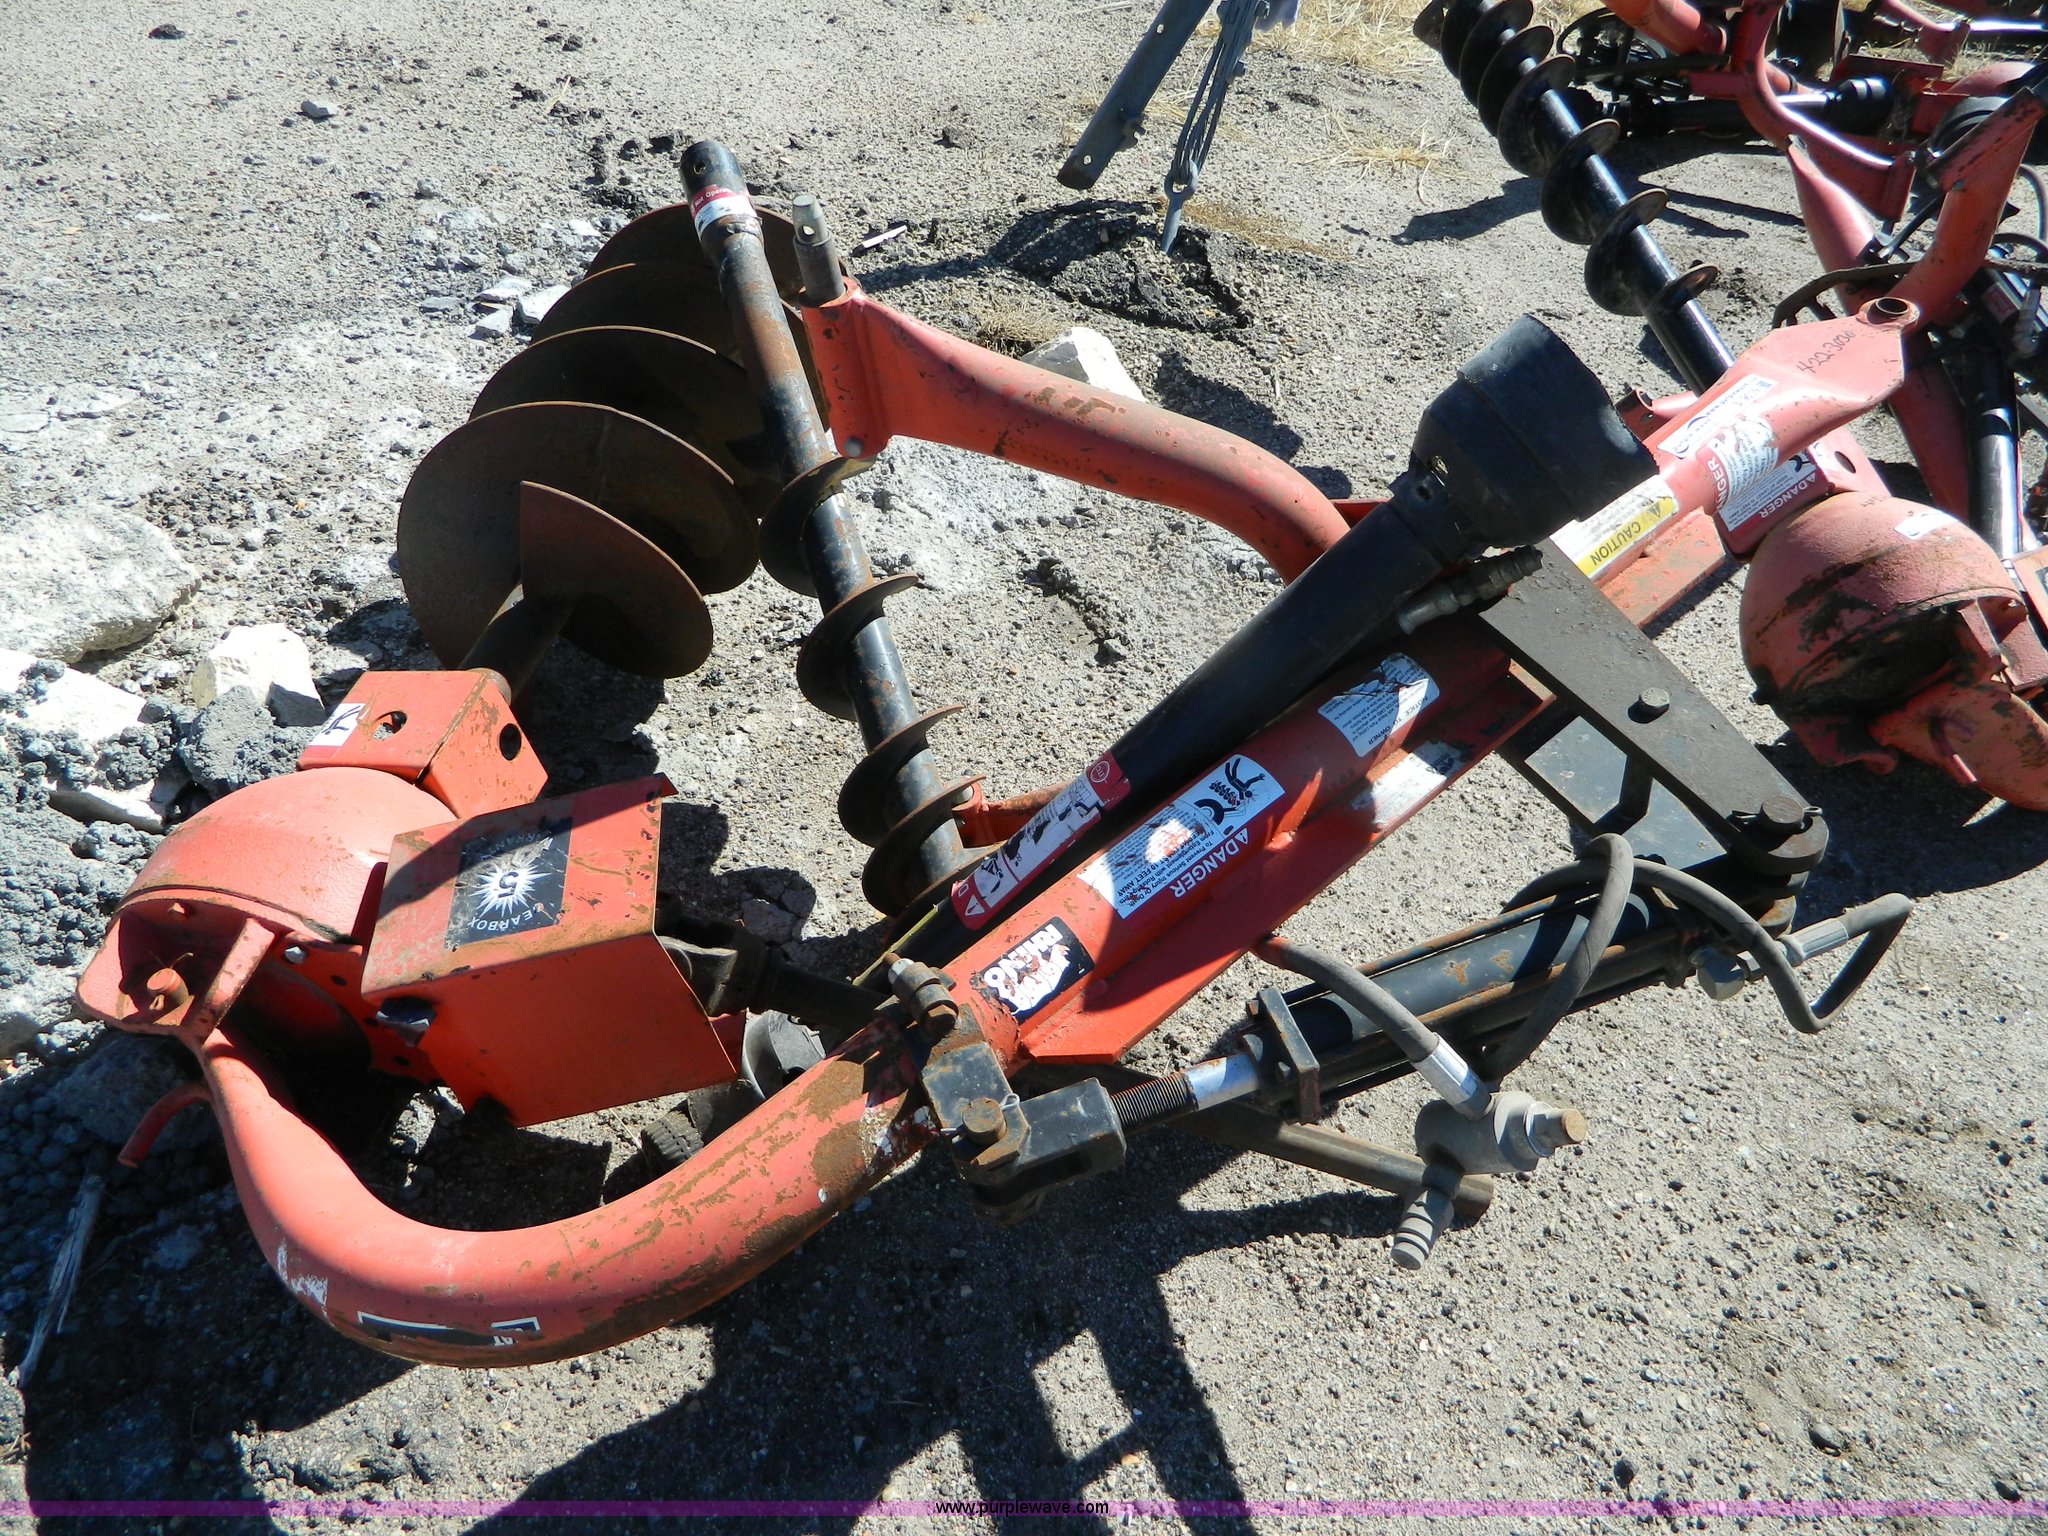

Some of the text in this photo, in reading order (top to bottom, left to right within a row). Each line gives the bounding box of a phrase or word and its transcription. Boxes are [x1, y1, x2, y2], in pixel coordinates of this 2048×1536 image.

[1758, 479, 1808, 518] DANGER
[1589, 520, 1642, 565] CAUTION
[1366, 695, 1428, 745] NOTICE TO OWNER
[1199, 829, 1214, 842] From
[1204, 840, 1213, 848] To
[1164, 838, 1201, 869] Entanglement
[1184, 845, 1206, 863] Prevent
[1133, 867, 1152, 883] FEET
[1149, 861, 1159, 871] 10
[1153, 865, 1167, 878] with
[1165, 860, 1187, 878] Serious
[1170, 839, 1240, 898] DANGER
[491, 870, 523, 899] 5
[1115, 879, 1135, 897] AWAY
[1149, 874, 1167, 890] Injury
[1117, 890, 1134, 905] arts
[982, 923, 1063, 989] RHINO
